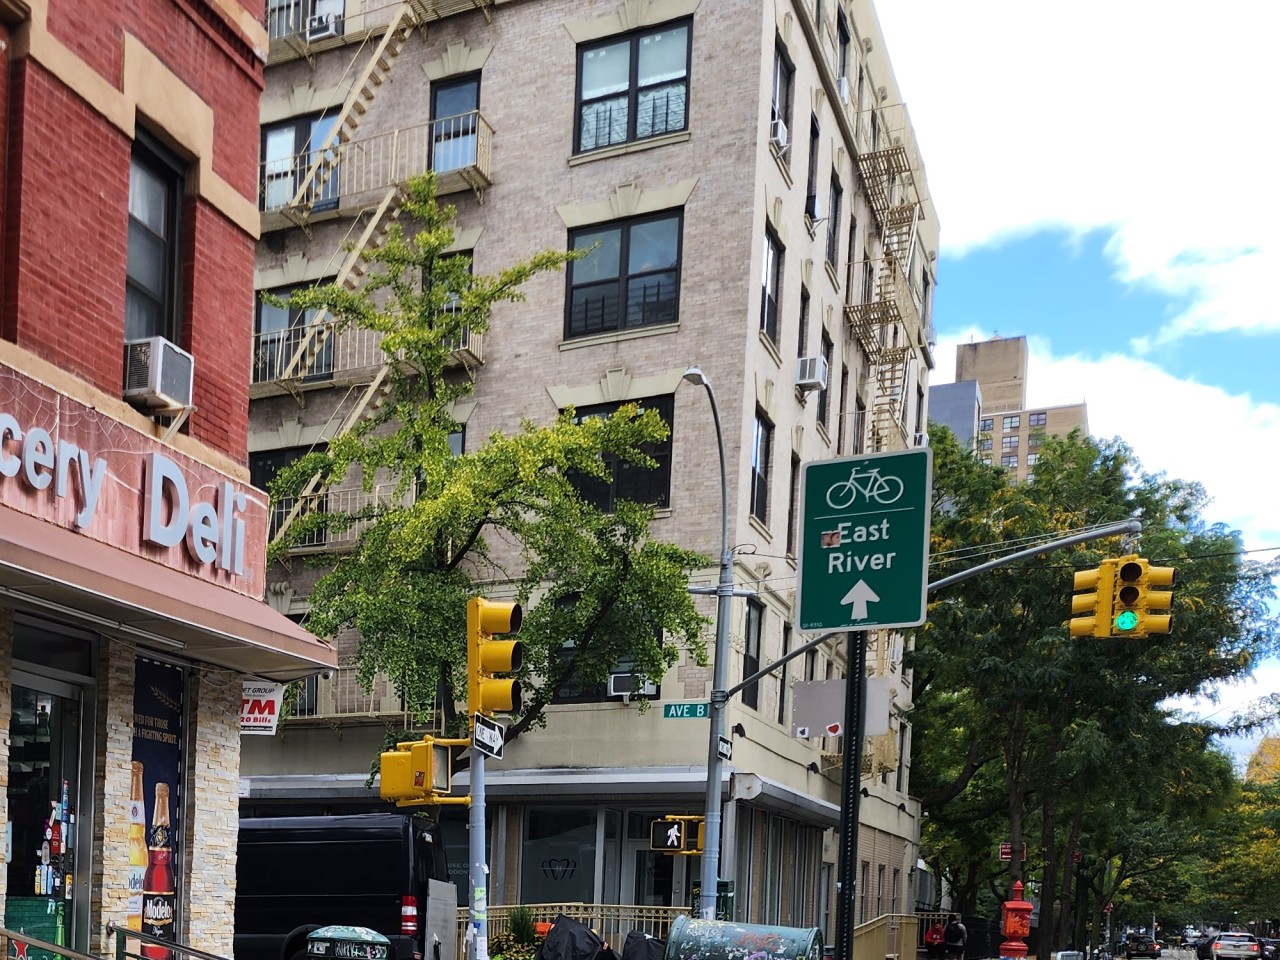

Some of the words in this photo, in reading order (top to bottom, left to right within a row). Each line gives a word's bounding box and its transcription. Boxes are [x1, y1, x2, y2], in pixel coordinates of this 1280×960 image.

[144, 452, 247, 576] Deli
[837, 518, 890, 544] East
[828, 551, 897, 574] River
[669, 705, 690, 717] AVE
[696, 704, 705, 717] B
[476, 724, 485, 741] ONE
[488, 730, 500, 746] WAY
[146, 899, 170, 919] Modelo
